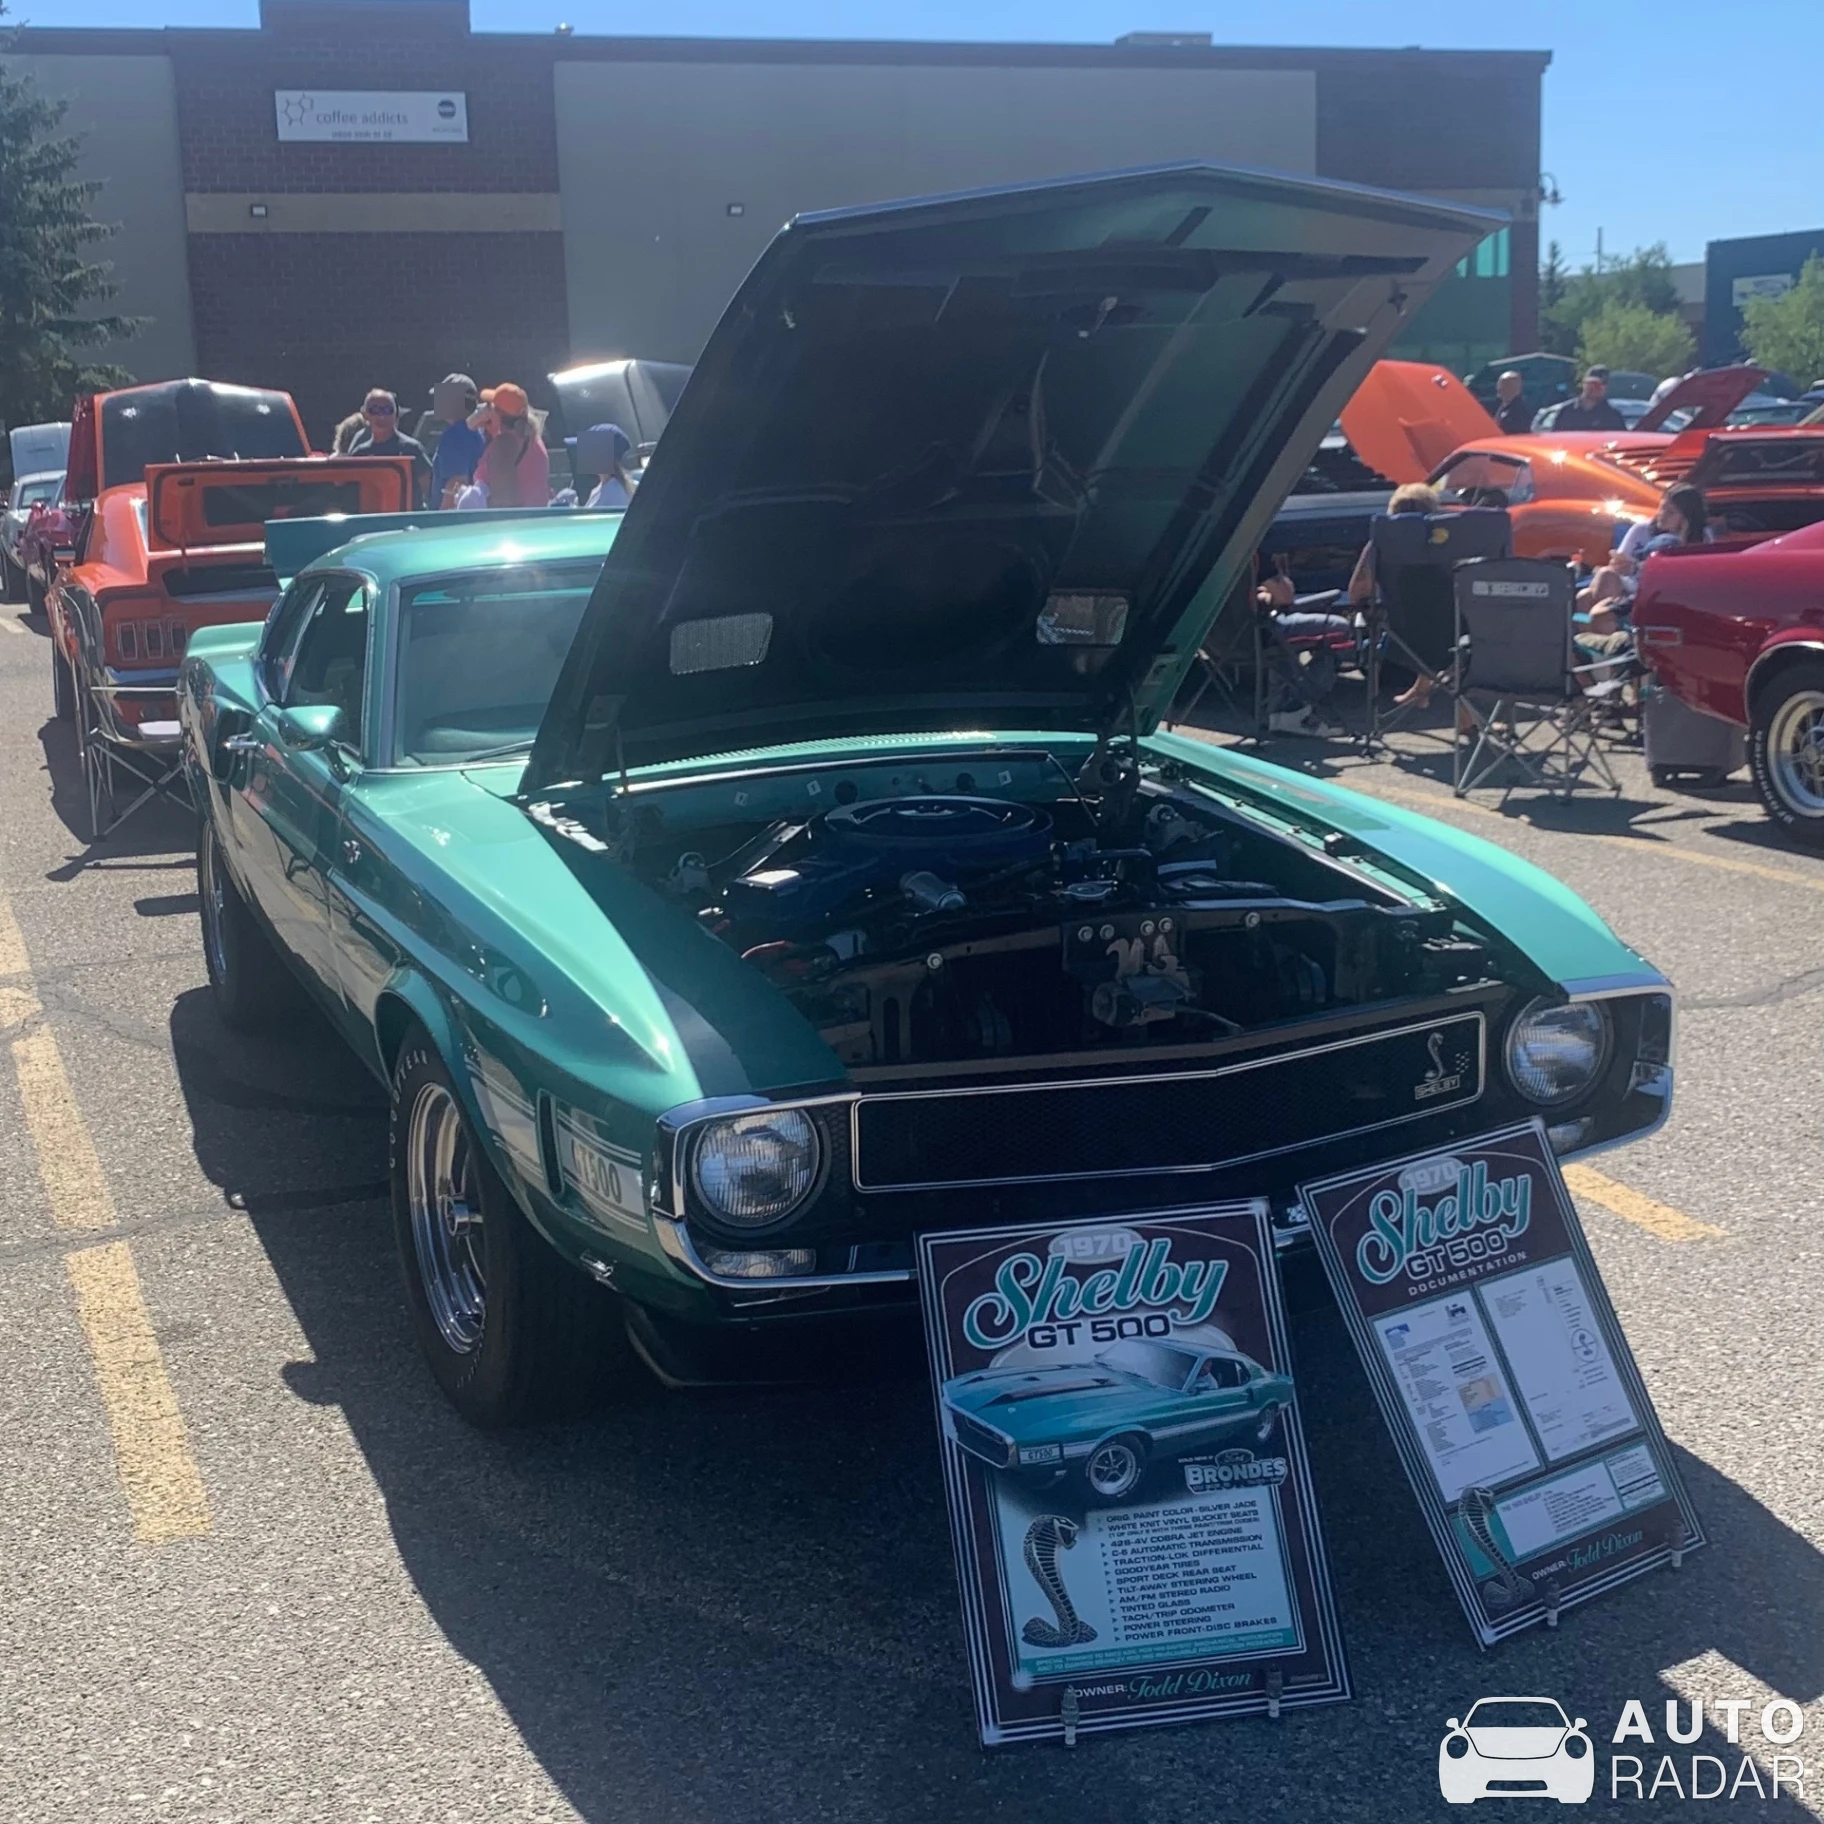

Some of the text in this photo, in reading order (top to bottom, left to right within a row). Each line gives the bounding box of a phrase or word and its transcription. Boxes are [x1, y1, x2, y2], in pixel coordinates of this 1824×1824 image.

[317, 110, 408, 125] coffee addicts
[1404, 1163, 1456, 1189] 1970
[1357, 1160, 1531, 1284] Shelby
[1059, 1233, 1132, 1258] 1970
[1404, 1227, 1507, 1280] GT 500
[1408, 1251, 1527, 1296] DOCUMENTATION
[963, 1238, 1229, 1349] Shelby
[1026, 1313, 1171, 1349] GT 500
[1188, 1459, 1286, 1485] BRONDES
[1108, 1509, 1258, 1532] WHITE KNIT VINYL BUCKET SEATS
[1133, 1510, 1159, 1519] PAINT
[1162, 1506, 1193, 1516] COLOR
[1198, 1502, 1230, 1512] SILVER
[1232, 1499, 1256, 1508] JADE
[1110, 1537, 1148, 1547] 428-4V
[1150, 1533, 1185, 1543] COBRA
[1207, 1526, 1242, 1536] ENGINE
[1111, 1533, 1263, 1557] C-6 AUTOMATIC TRANSMISSION
[1113, 1543, 1263, 1566] TRACTION-LOK DIFFERENTIAL
[1531, 1530, 1643, 1580] OWNER: Todd Dixon
[1114, 1559, 1200, 1575] GOODYEAR TIRES
[1116, 1564, 1237, 1584] SPORT DECK REAR SEAT
[1117, 1572, 1257, 1594] TILT-AWAY STEERING WHEEL
[1118, 1584, 1230, 1603] AM/FM STEREO RADIO
[1120, 1598, 1190, 1612] TINTED GLASS
[1121, 1603, 1235, 1622] TACH/TRIP ODOMETER
[1123, 1615, 1211, 1631] POWER STEERING
[1125, 1617, 1277, 1641] POWER FRONT-DISC BRAKES
[1074, 1669, 1251, 1700] OWNER: Todd Dixon
